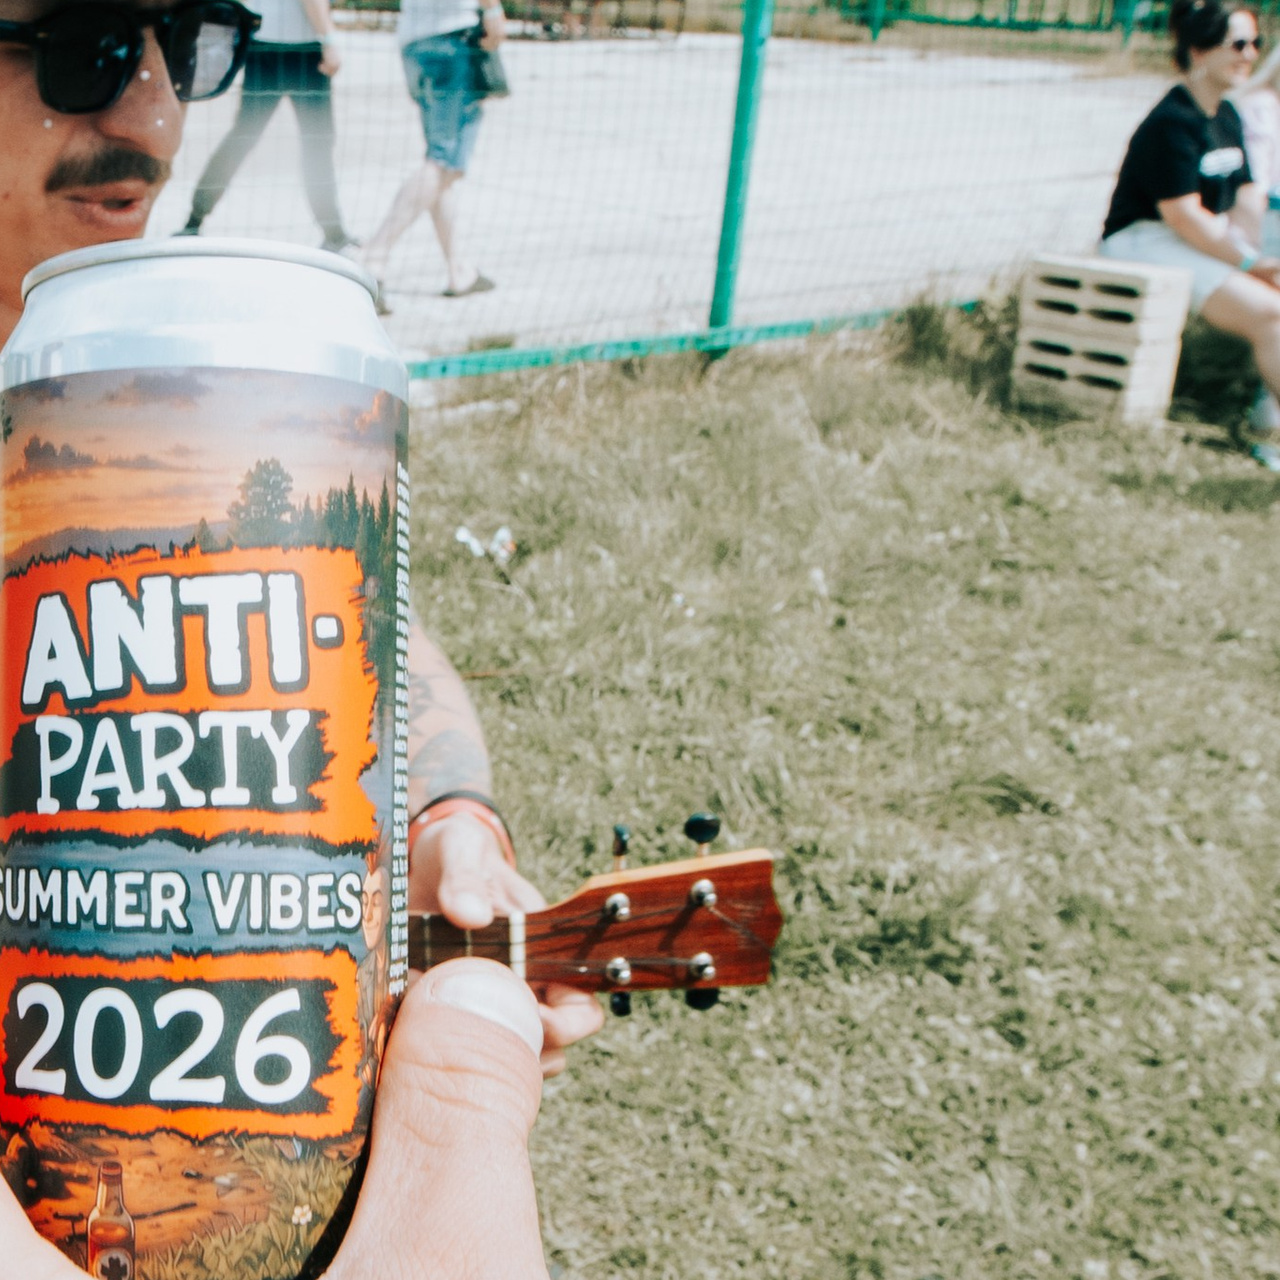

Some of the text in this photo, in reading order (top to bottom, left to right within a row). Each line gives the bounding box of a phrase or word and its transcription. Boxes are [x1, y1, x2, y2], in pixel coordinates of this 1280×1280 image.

[21, 570, 338, 707] ANTI-
[34, 709, 311, 815] PARTY
[206, 872, 362, 931] VIBES
[14, 981, 312, 1104] 2026
